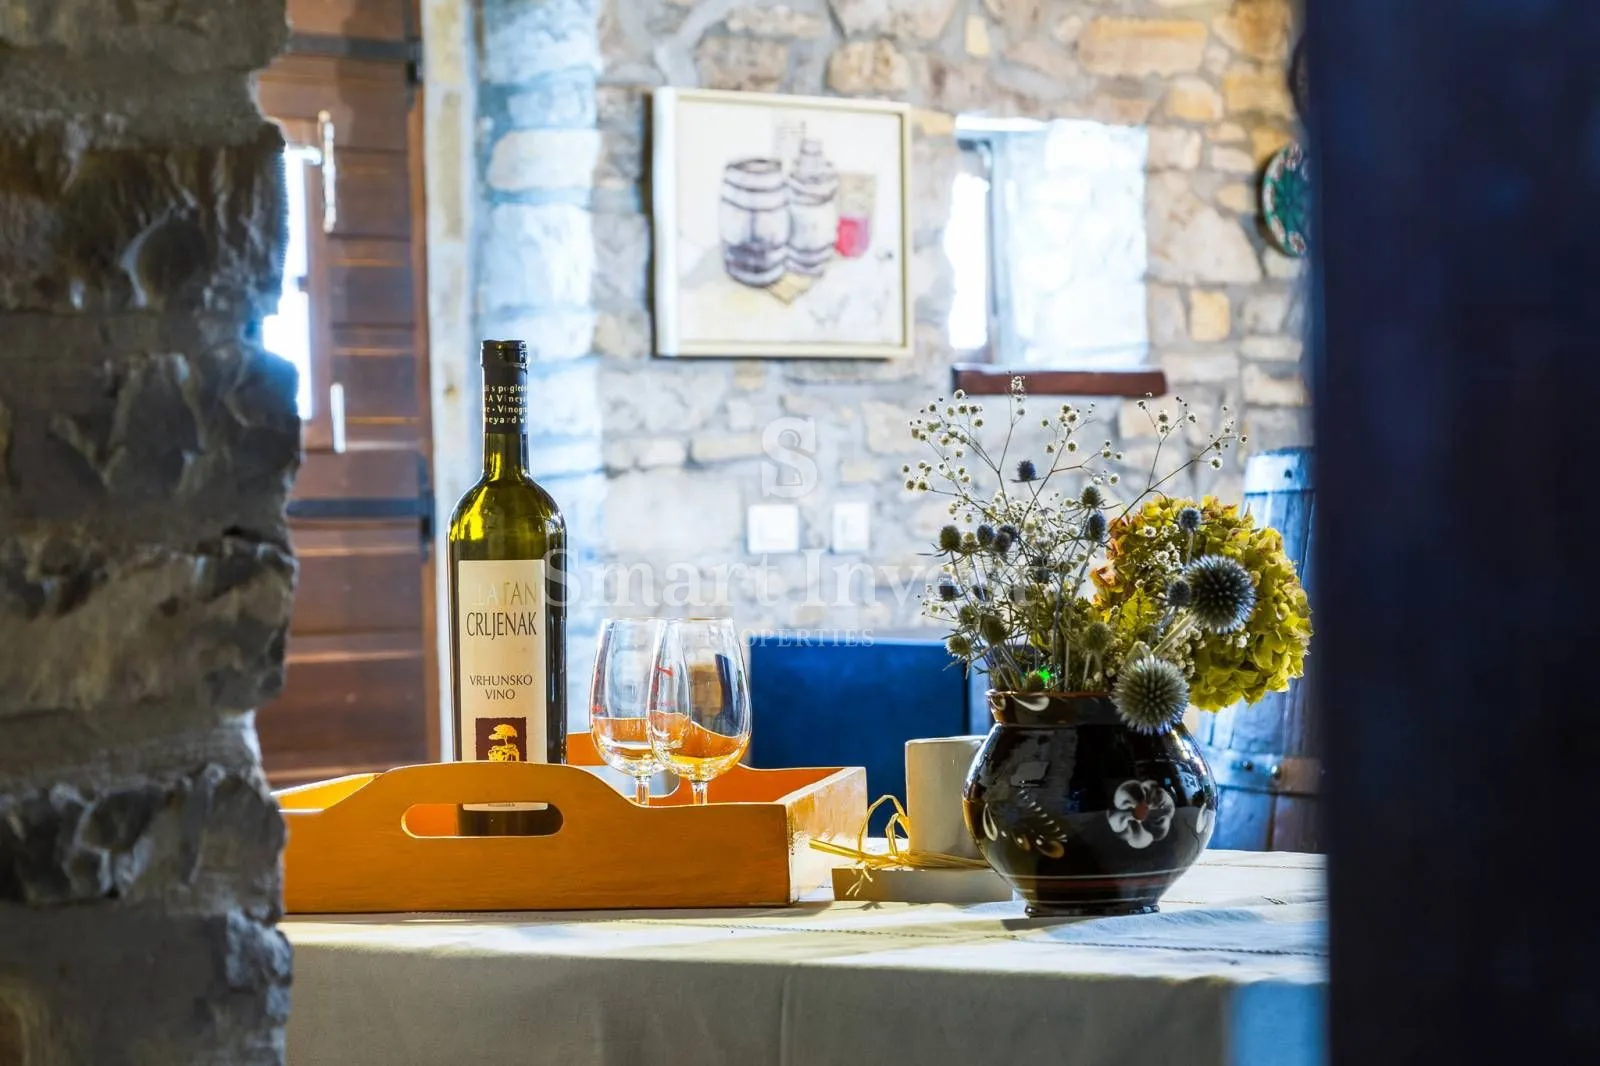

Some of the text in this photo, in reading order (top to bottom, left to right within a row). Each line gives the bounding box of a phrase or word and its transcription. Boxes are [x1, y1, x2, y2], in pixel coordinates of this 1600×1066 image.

[470, 581, 537, 605] LATAN
[466, 611, 537, 640] CRLJENAK
[469, 674, 533, 686] VRHUNSKO
[485, 688, 516, 700] VINO
